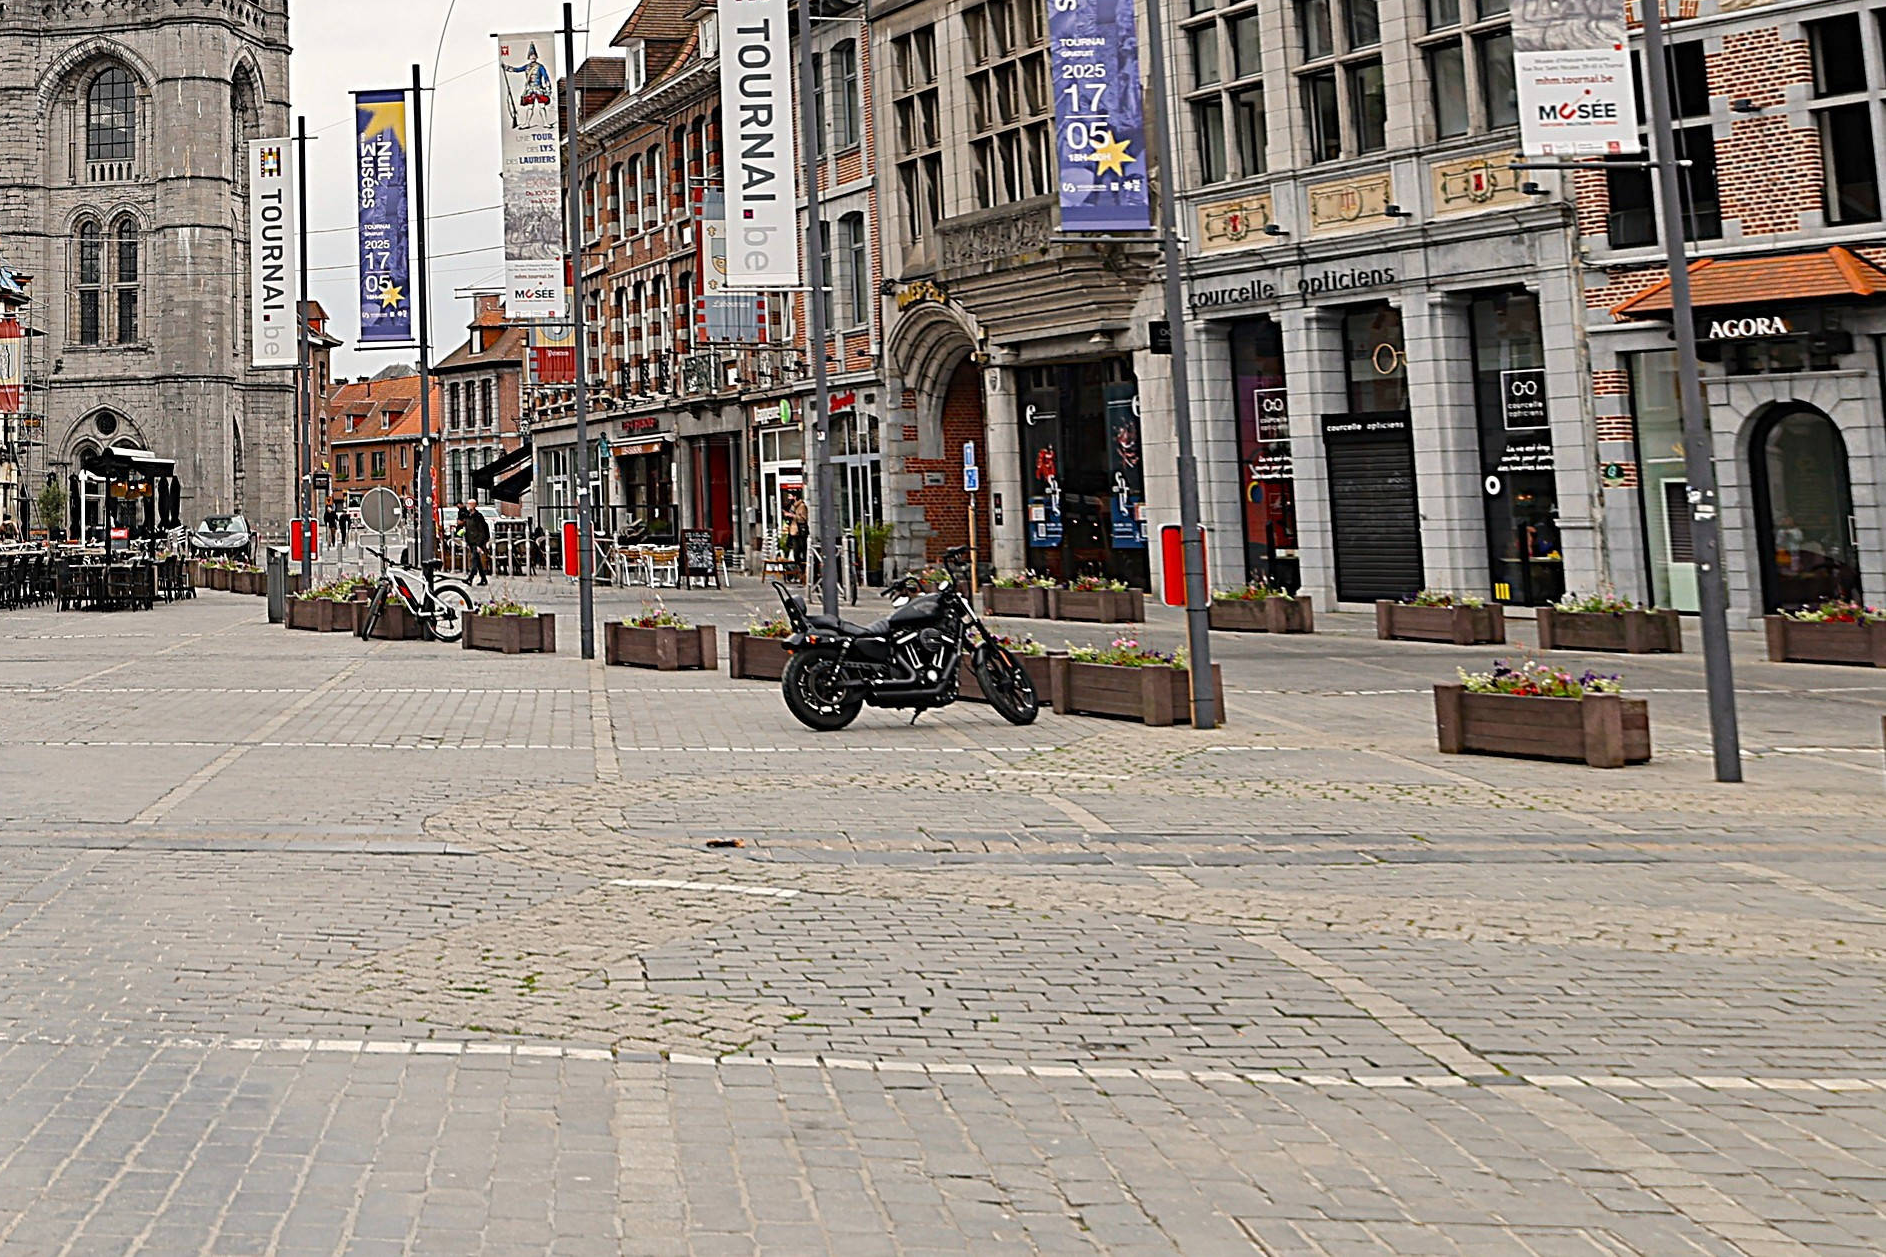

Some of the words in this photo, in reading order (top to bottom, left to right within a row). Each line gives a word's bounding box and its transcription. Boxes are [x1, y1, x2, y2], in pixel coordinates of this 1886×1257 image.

[1059, 38, 1105, 46] TOURNAI
[1062, 64, 1106, 79] 2025
[1064, 83, 1107, 112] 17
[1538, 99, 1617, 120] MUSÉE
[737, 18, 777, 271] TOURNAI.be
[1066, 122, 1110, 150] 05
[377, 142, 395, 180] Nuit
[519, 155, 556, 164] LAURIERS
[361, 142, 379, 209] Musées
[364, 240, 390, 249] 2025
[365, 252, 390, 270] 17
[261, 188, 285, 356] TOURNAI.be
[366, 275, 390, 292] 05
[515, 288, 555, 299] MUSÉE
[1188, 280, 1275, 308] courcelle
[1298, 267, 1395, 296] opticiens
[1709, 317, 1788, 338] AGORA
[1327, 423, 1362, 432] courcelle
[1367, 422, 1404, 430] opticiens
